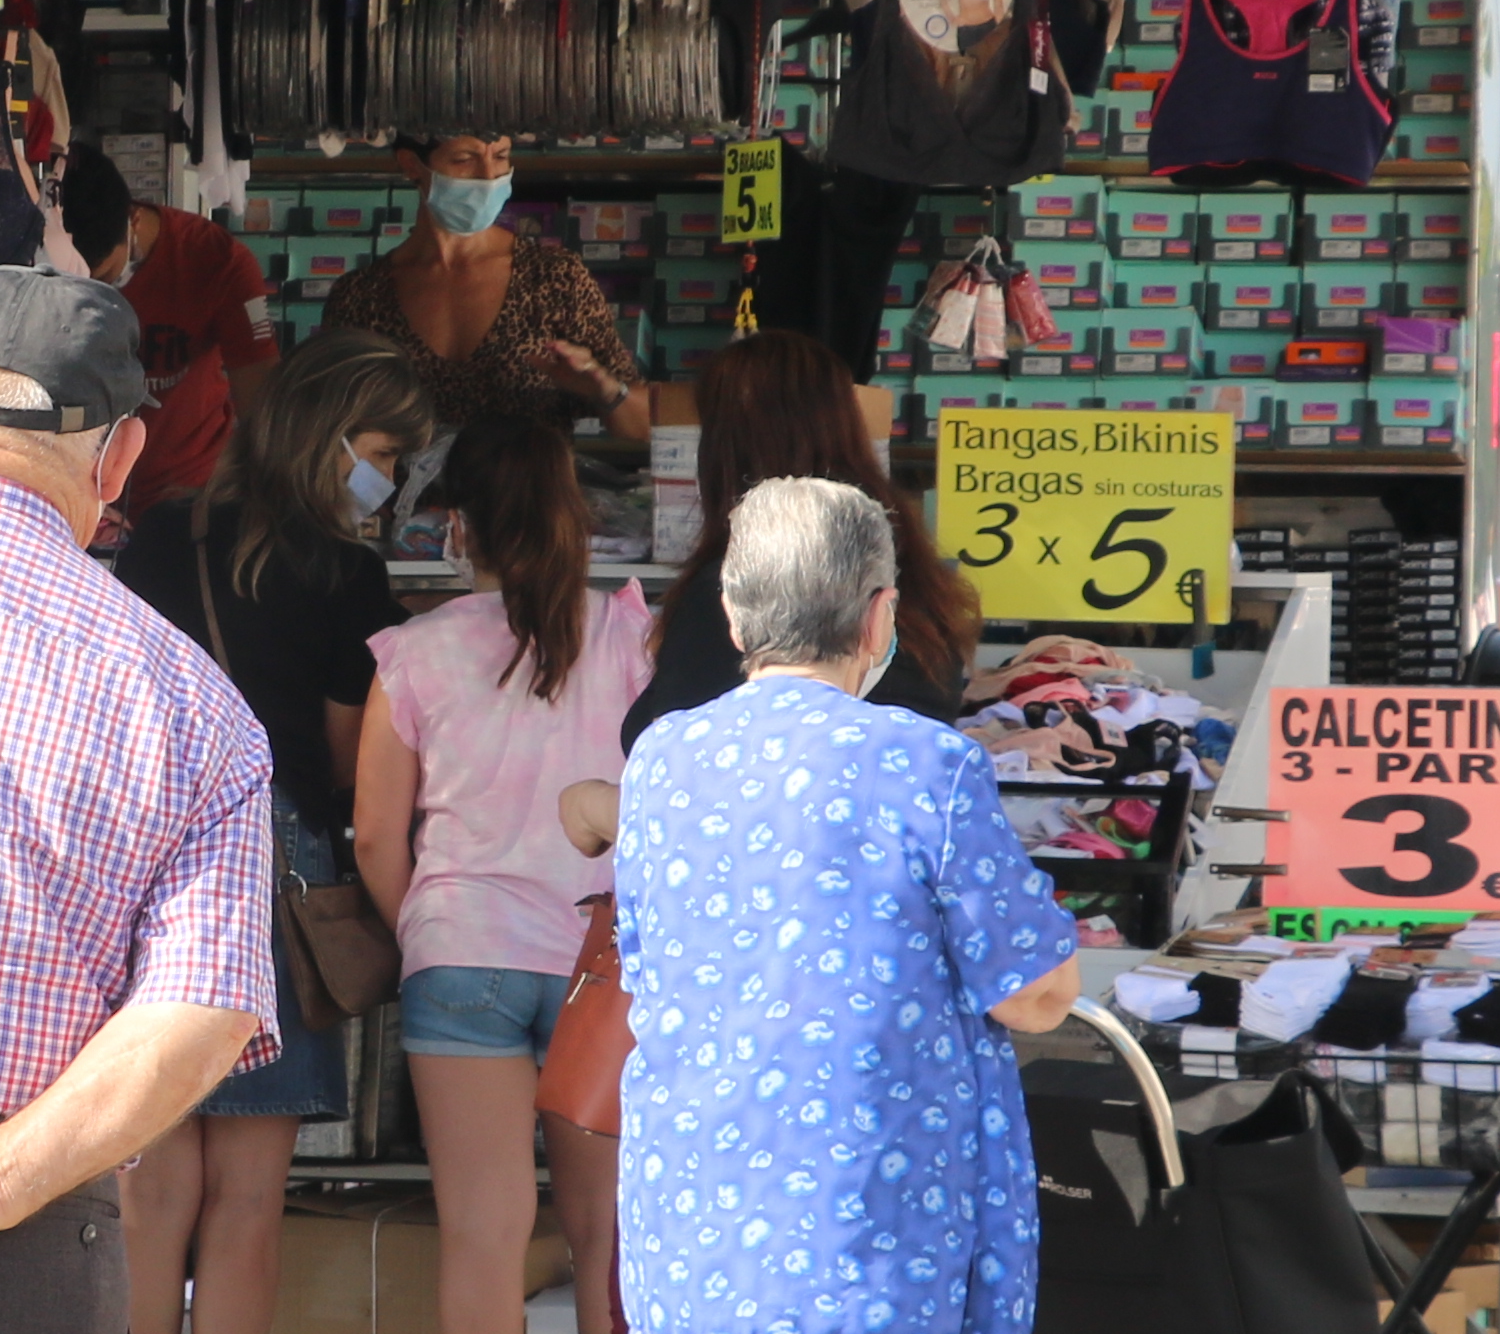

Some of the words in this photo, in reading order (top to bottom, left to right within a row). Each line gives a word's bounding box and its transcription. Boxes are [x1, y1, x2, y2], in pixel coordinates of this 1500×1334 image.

[954, 463, 1084, 503] Bragas
[1094, 481, 1125, 496] sin
[1132, 481, 1223, 498] costuras
[957, 502, 1020, 567] 3
[1281, 751, 1314, 782] 3
